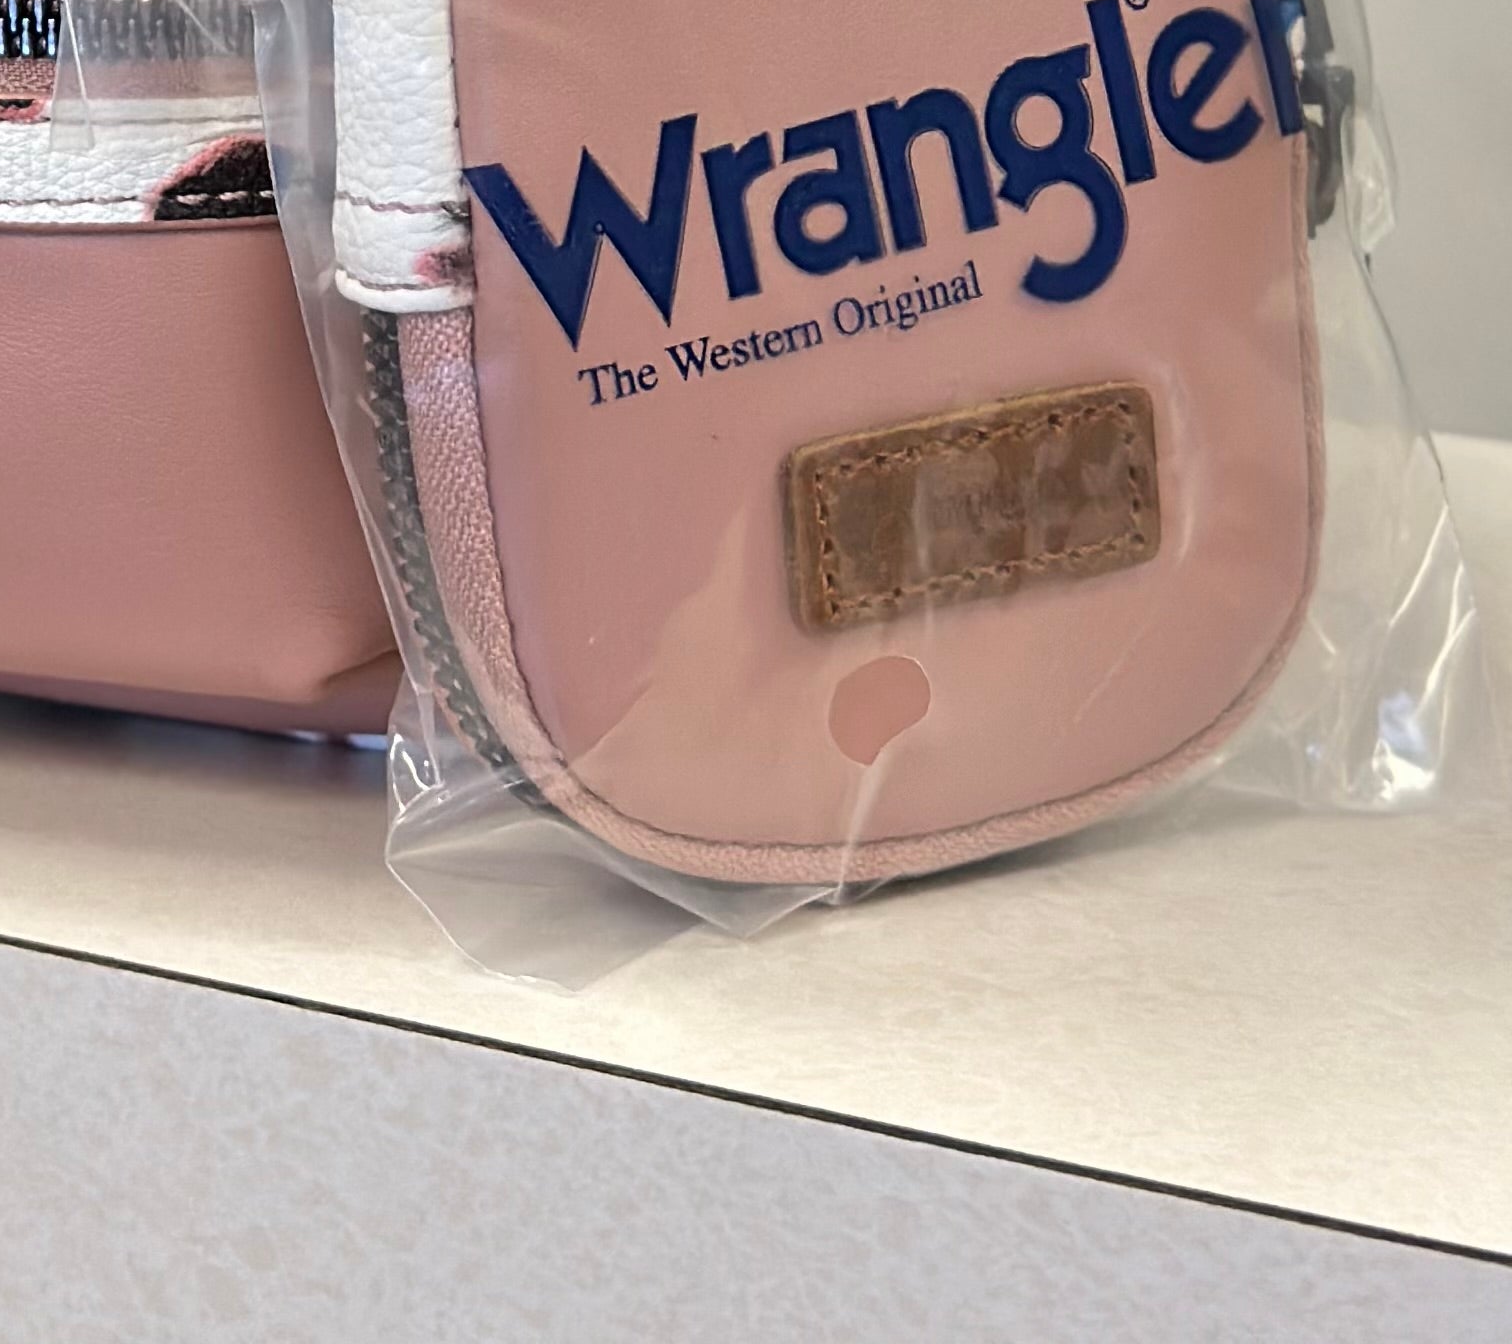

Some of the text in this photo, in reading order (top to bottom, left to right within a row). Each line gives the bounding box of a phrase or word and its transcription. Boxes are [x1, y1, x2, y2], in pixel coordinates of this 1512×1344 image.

[577, 259, 984, 407] The Western Original
